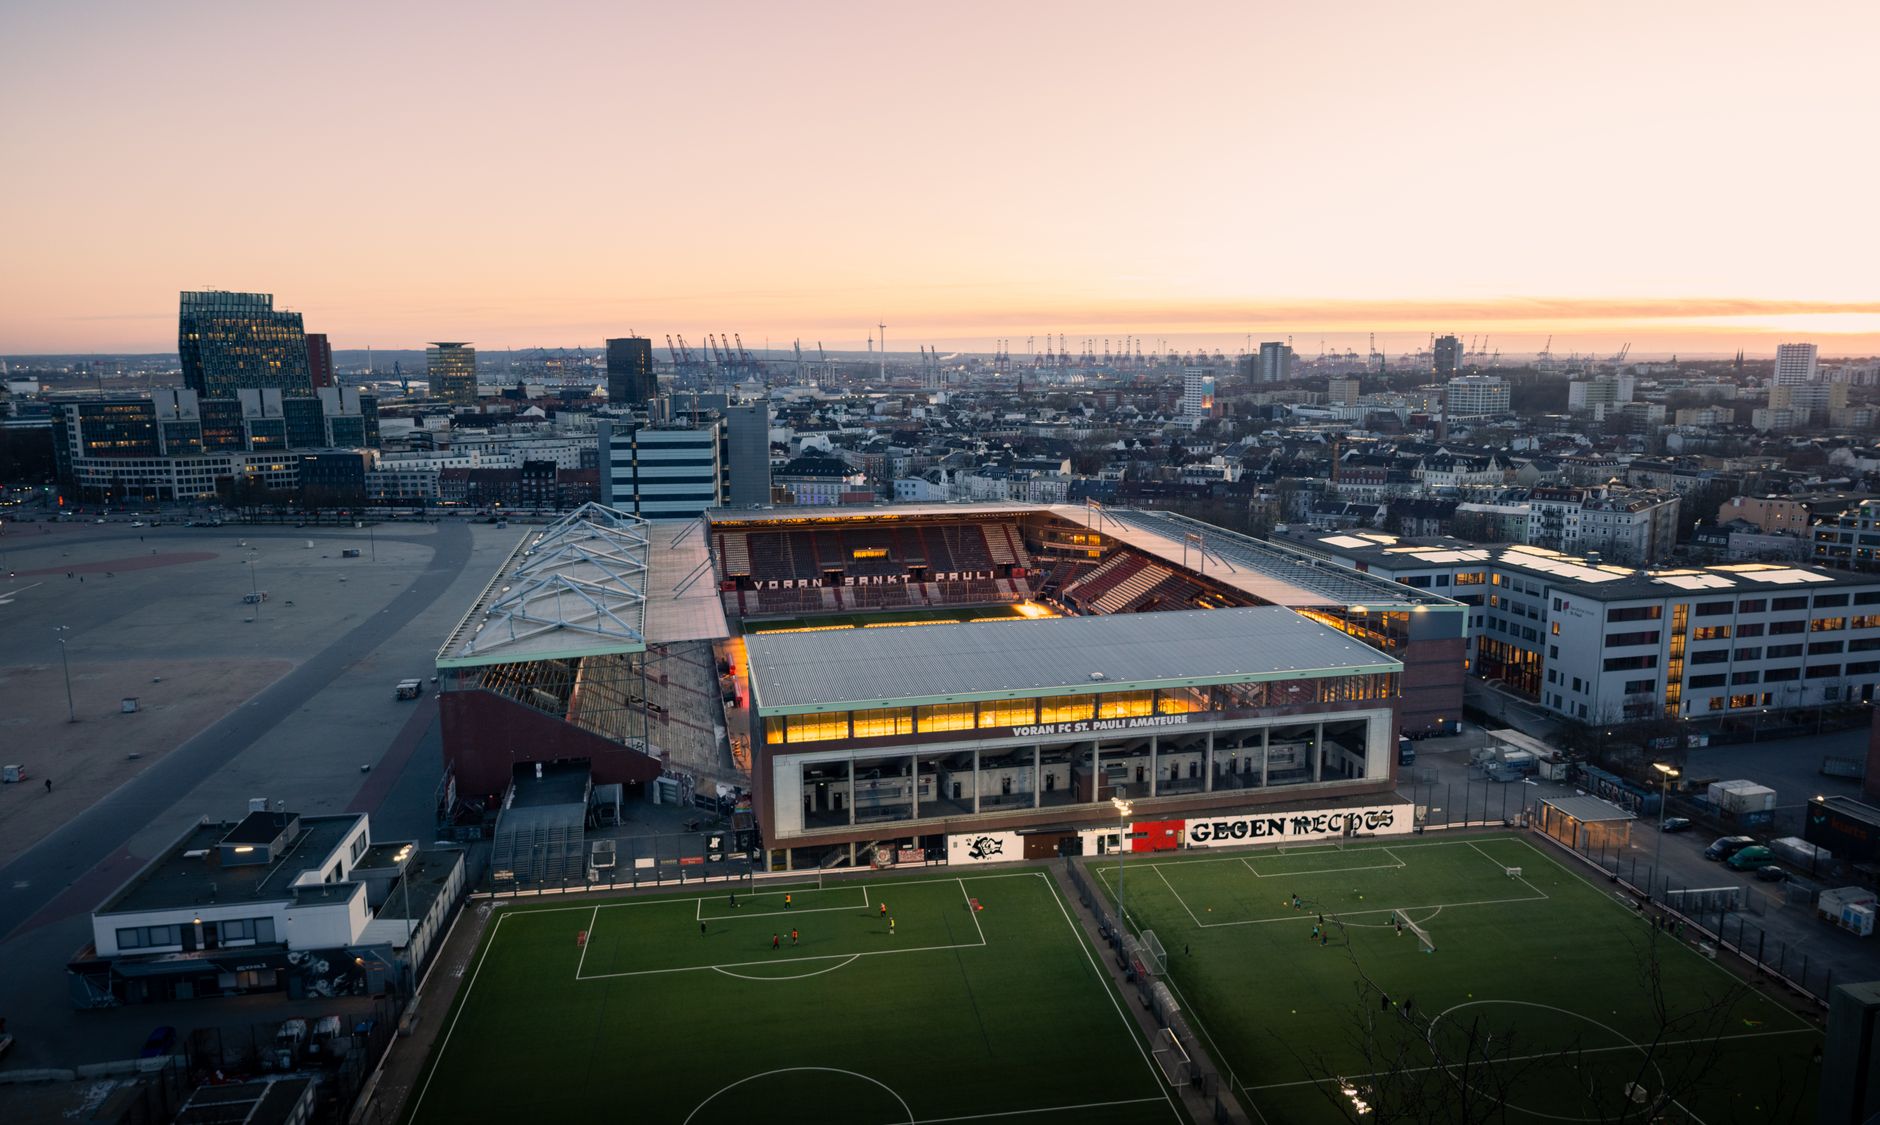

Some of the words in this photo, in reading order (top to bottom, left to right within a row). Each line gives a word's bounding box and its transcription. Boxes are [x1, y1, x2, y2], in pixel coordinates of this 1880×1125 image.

[754, 578, 823, 590] VORAN
[844, 574, 911, 586] SANKT
[935, 570, 995, 582] PAULI
[1013, 725, 1055, 737] VORAN
[1058, 723, 1072, 733] FC
[1074, 722, 1090, 732] ST.
[1093, 719, 1126, 731] PAULI
[1129, 715, 1188, 728] AMATEURE
[1190, 818, 1287, 842] GEGEN
